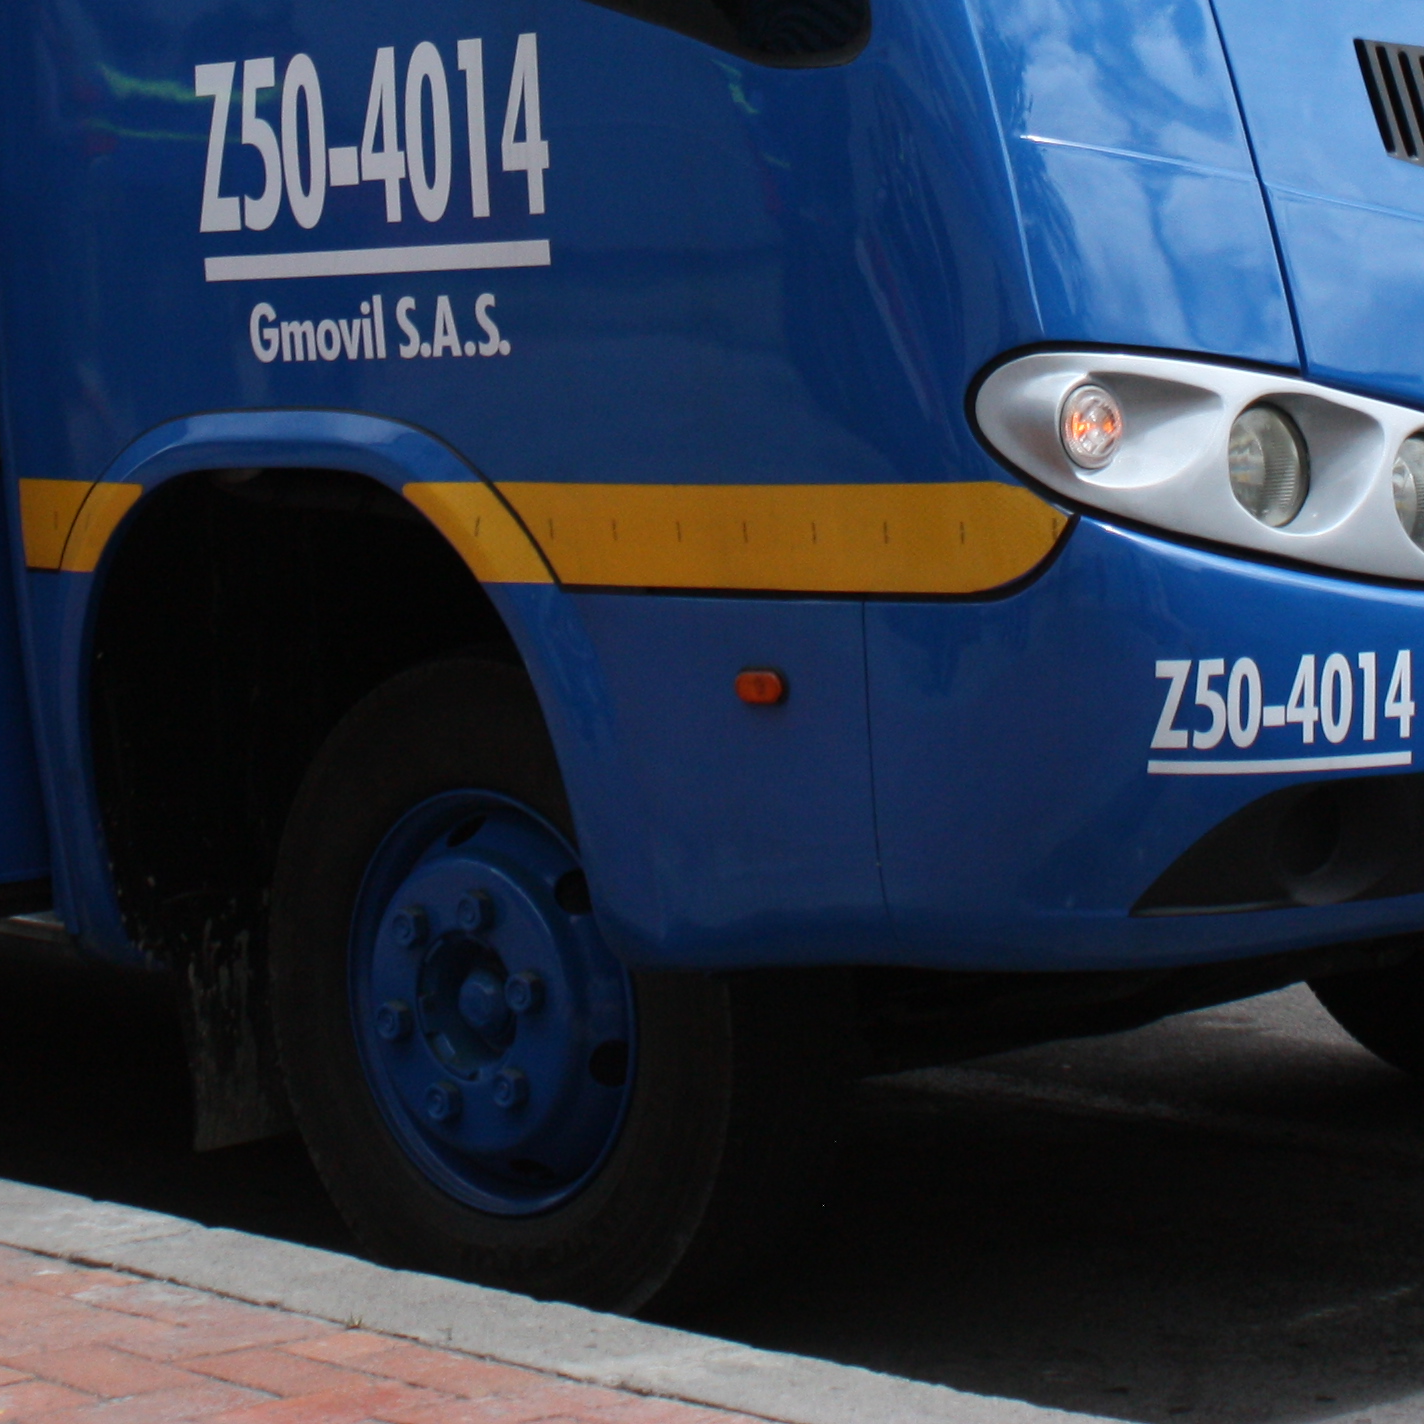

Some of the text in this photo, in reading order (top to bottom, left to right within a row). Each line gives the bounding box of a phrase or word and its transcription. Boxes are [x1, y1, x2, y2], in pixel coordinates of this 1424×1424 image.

[194, 31, 551, 233] Z50-4014
[249, 292, 512, 364] Gmovil S.A.S.
[1149, 649, 1416, 750] Z50-4014
